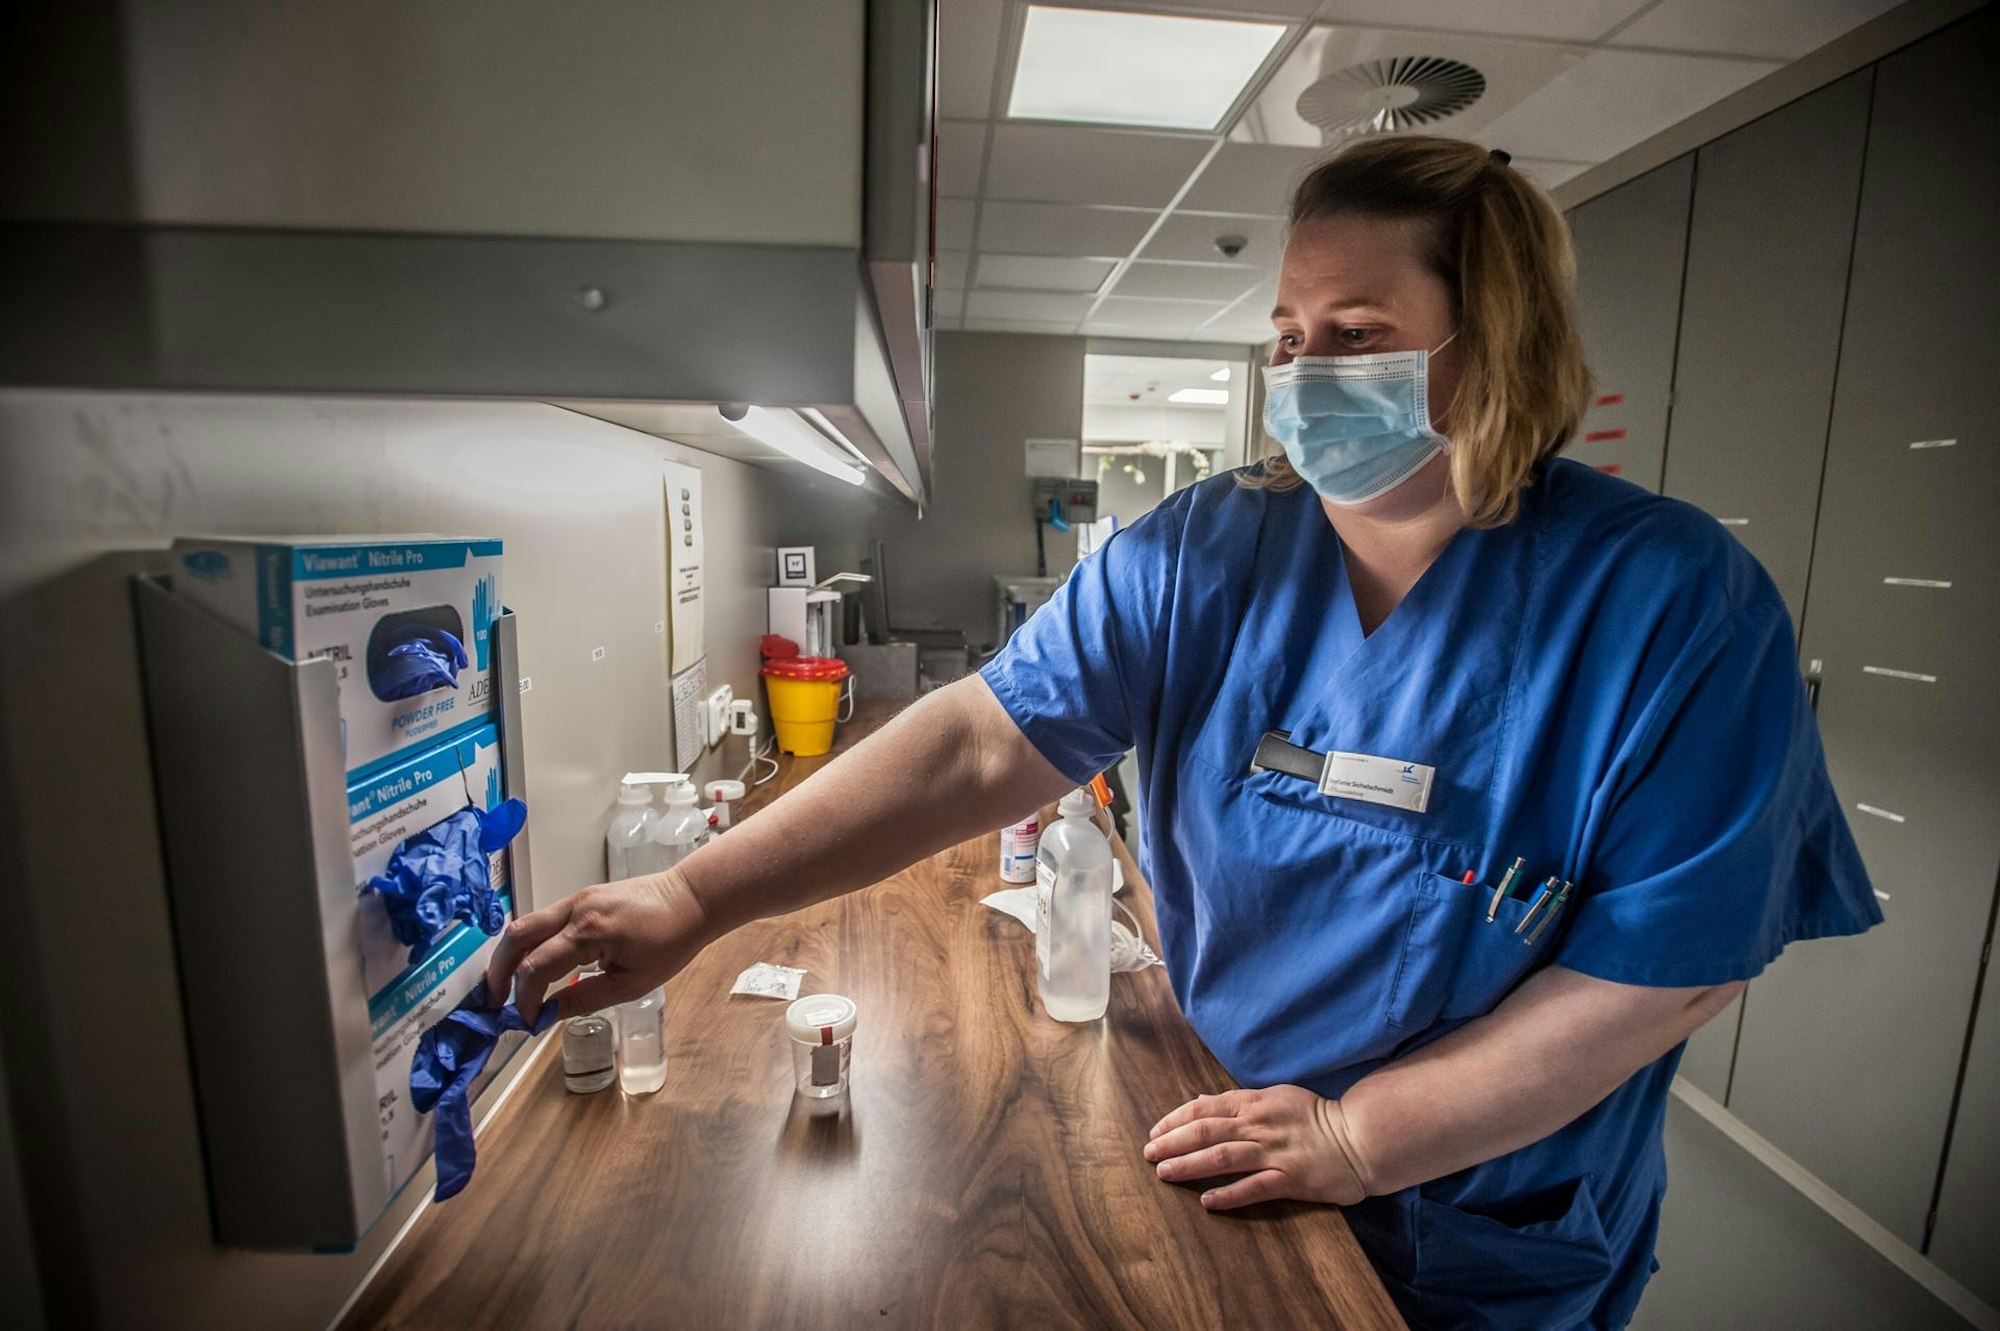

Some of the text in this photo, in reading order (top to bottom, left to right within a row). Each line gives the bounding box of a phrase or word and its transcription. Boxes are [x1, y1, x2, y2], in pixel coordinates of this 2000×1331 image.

[367, 550, 403, 568] Nitrile
[405, 549, 424, 565] Pro
[303, 577, 411, 599] Untersuchungshandschuhe
[304, 597, 390, 617] Examination Gloves
[476, 628, 488, 641] 100
[391, 697, 455, 731] POWDER FREE
[376, 769, 433, 804] Nitrile Pro
[404, 955, 456, 1004] Nitrile Pro
[378, 1088, 399, 1114] RIL
